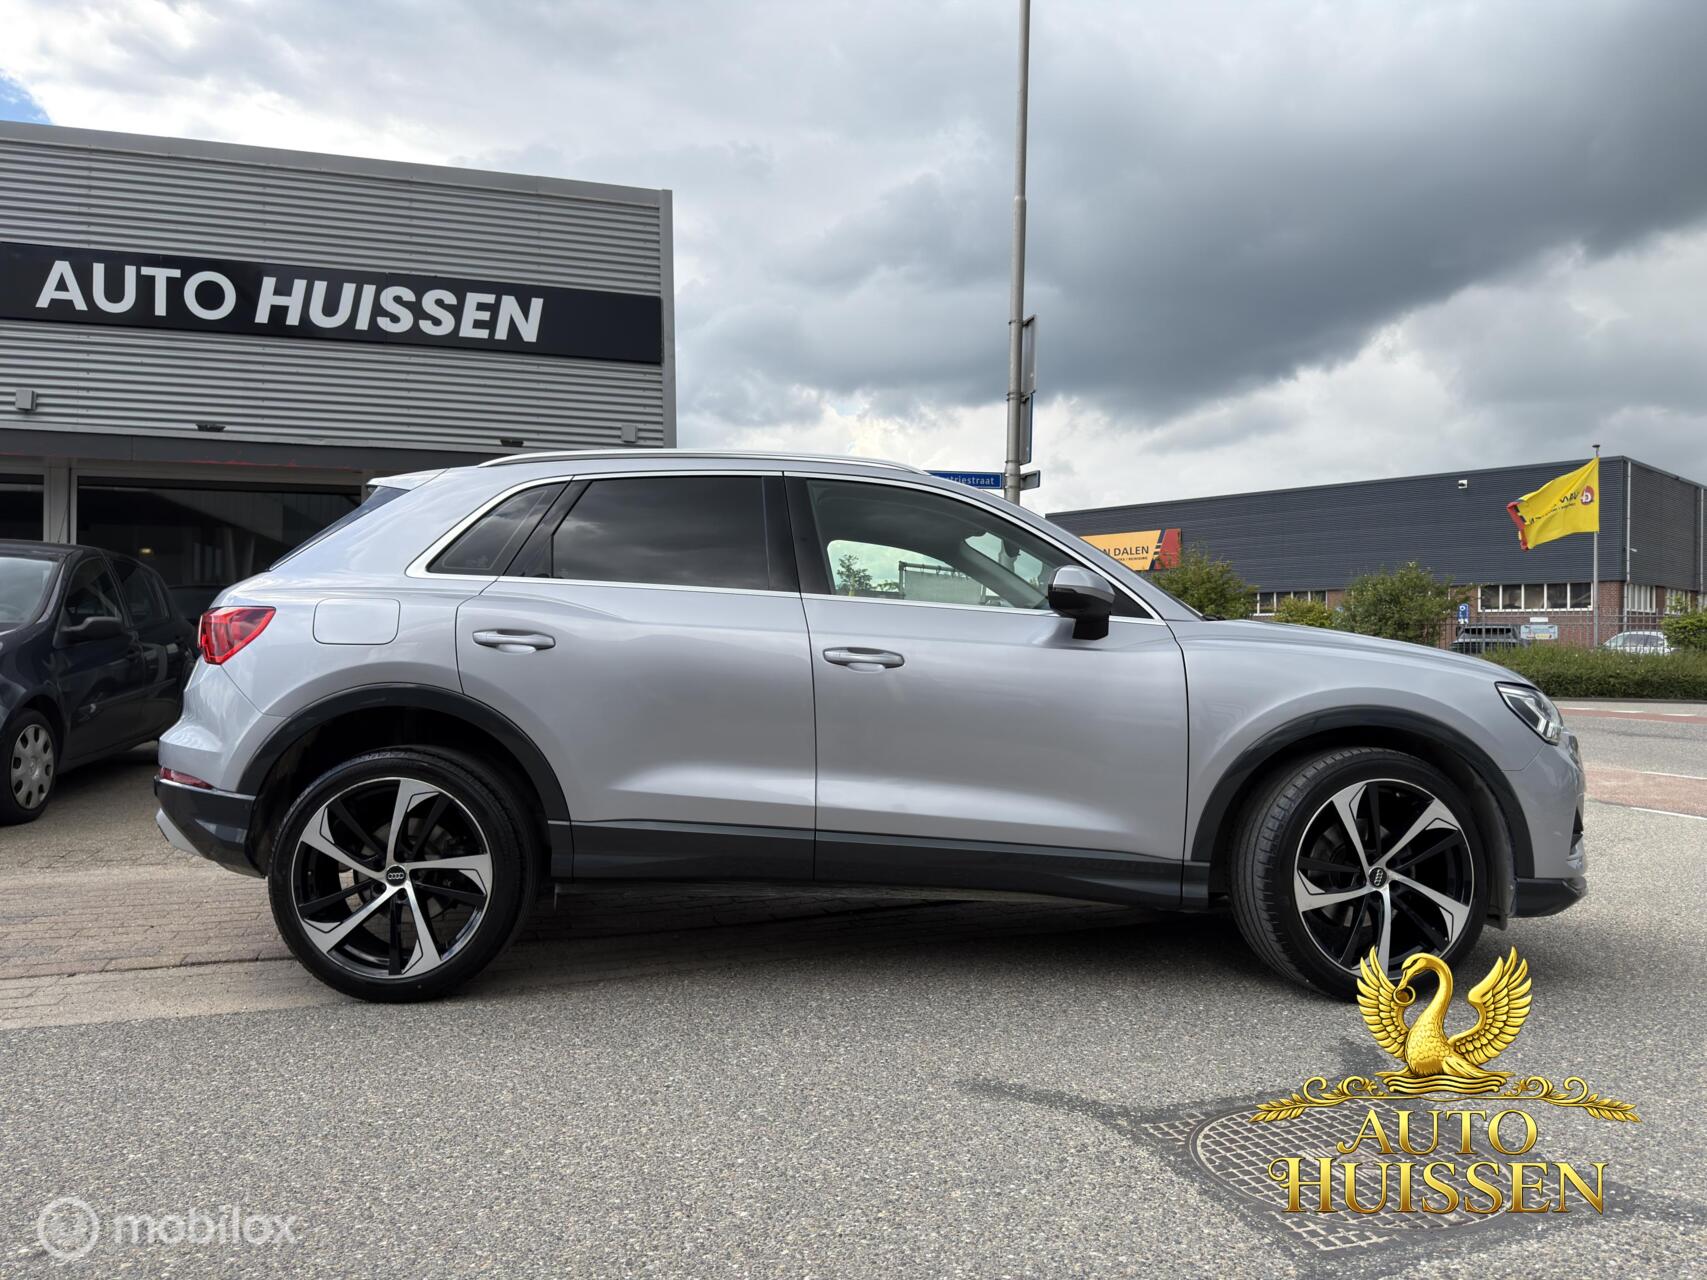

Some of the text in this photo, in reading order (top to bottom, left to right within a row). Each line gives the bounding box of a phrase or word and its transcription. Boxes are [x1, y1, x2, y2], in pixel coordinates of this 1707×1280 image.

[35, 260, 544, 343] AUTO HUISSEN
[1113, 545, 1149, 557] DALEN
